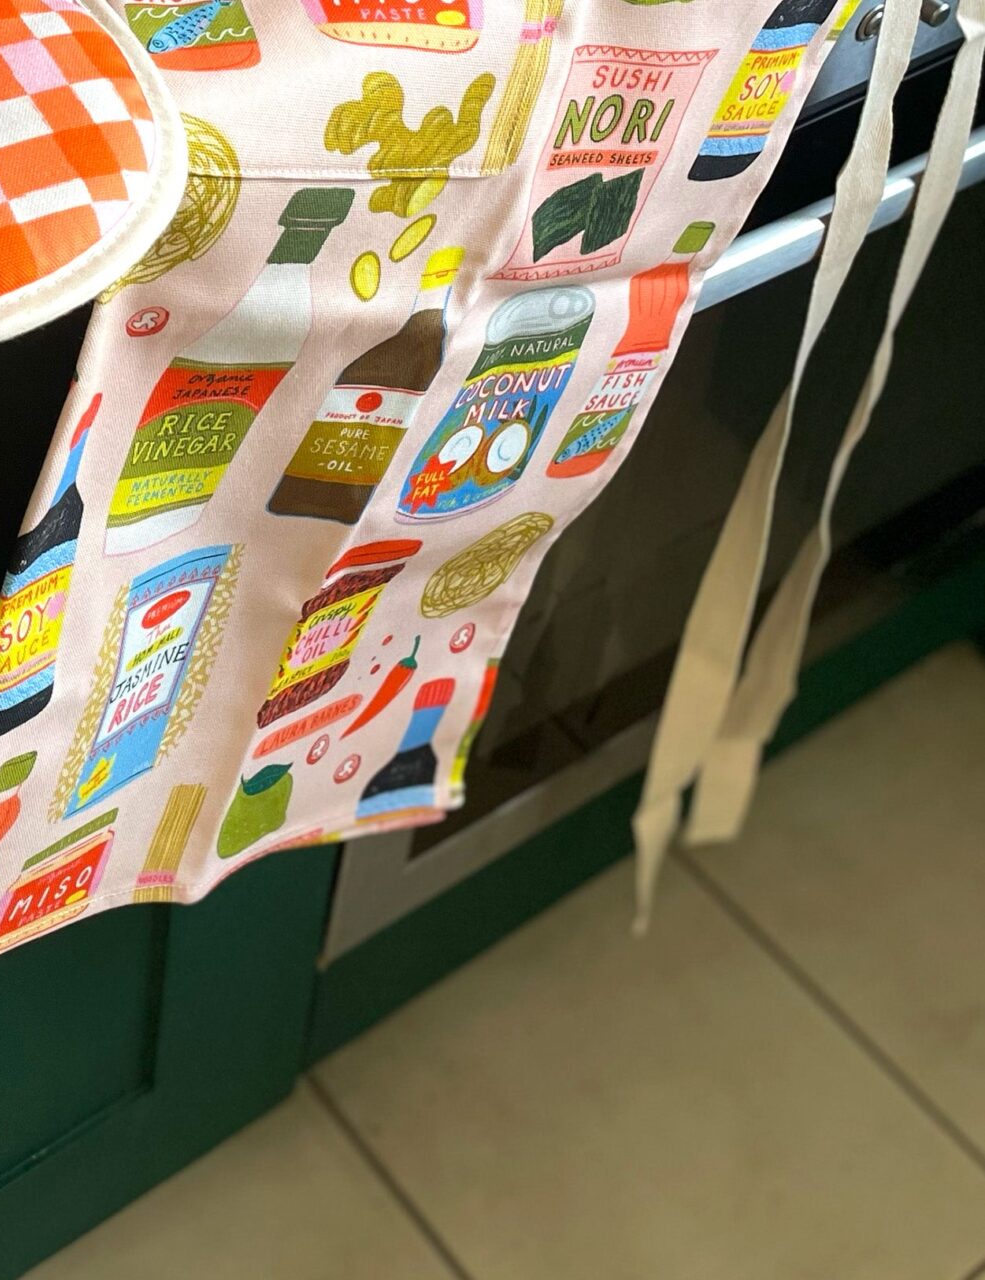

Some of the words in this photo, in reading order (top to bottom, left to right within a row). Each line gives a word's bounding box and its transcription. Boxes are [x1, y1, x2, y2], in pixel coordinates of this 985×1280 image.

[360, 7, 428, 22] PASTE
[592, 64, 675, 93] SUSHI
[739, 71, 788, 101] SOY
[553, 94, 676, 149] NORI
[722, 100, 779, 122] SAUCE
[549, 151, 603, 167] SEAWEED
[609, 151, 653, 165] SHEETS
[510, 336, 575, 358] NATURAL
[188, 373, 256, 387] organic
[455, 363, 572, 409] COCONUT
[601, 372, 648, 391] FISH
[172, 386, 252, 400] JAPANESE
[584, 391, 641, 411] SAUCE
[157, 410, 234, 436] RICE
[464, 399, 530, 426] MILK
[340, 428, 371, 440] PURE
[131, 432, 236, 465] VINEGAR
[310, 438, 390, 462] SESAME
[132, 470, 214, 491] NATURALLY
[417, 471, 446, 484] FULL
[127, 482, 205, 507] FERMENTED
[413, 484, 440, 502] FAT
[295, 618, 352, 655] CHILLI
[302, 643, 327, 664] OIL
[109, 641, 190, 704] JASMINE
[107, 672, 165, 734] RICE
[261, 719, 308, 754] LAURA
[8, 865, 92, 921] MISO
[18, 900, 64, 926] PASTE
